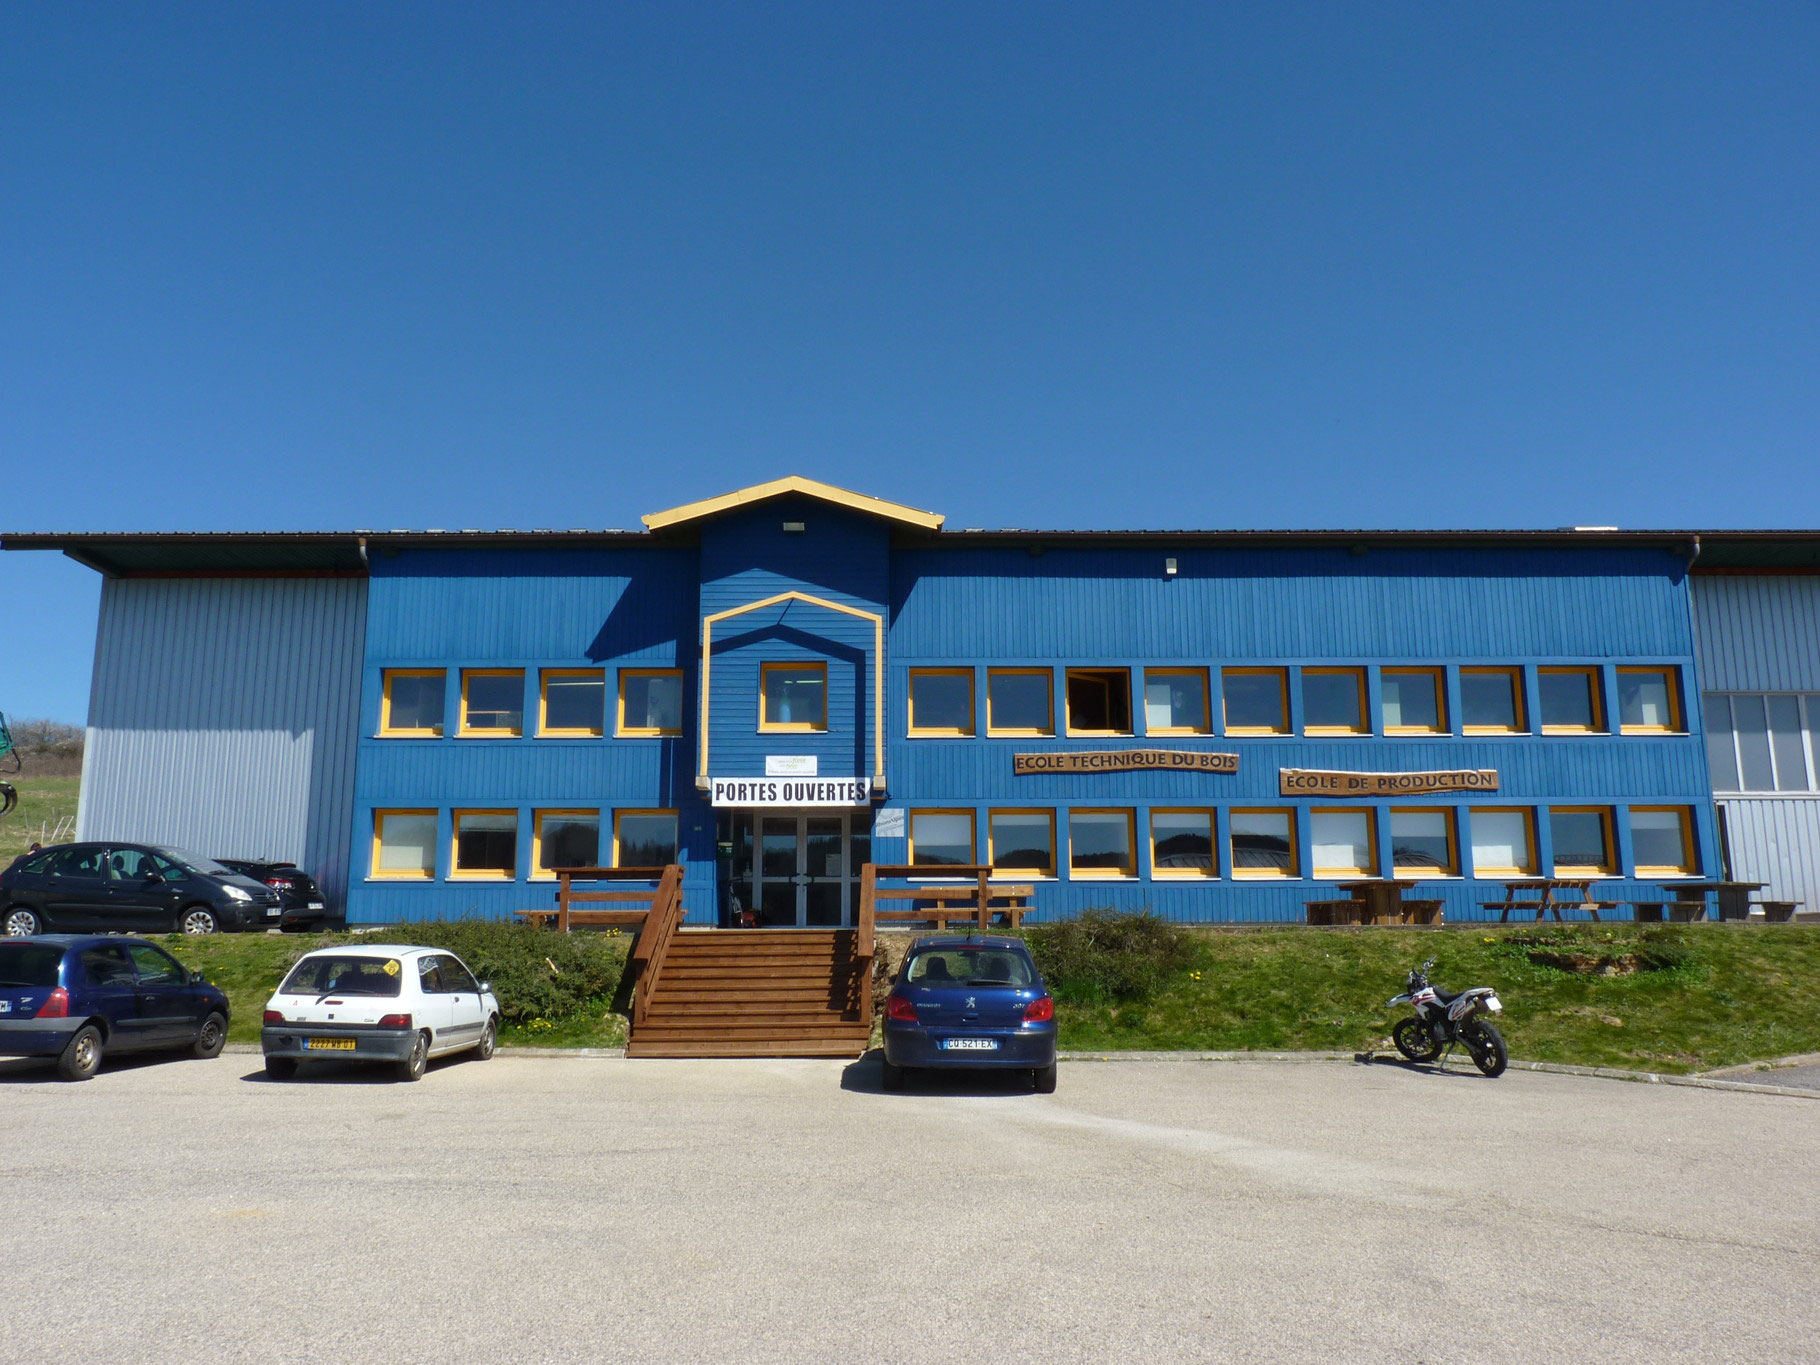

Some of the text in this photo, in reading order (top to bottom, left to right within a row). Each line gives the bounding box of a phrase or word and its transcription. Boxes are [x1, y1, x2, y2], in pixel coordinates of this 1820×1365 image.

[1016, 752, 1235, 769] ECOLE TECHNIQUE DU BOIS
[1286, 773, 1493, 789] ECOLE DE PRODUCTION
[715, 782, 866, 801] PORTES OUVERTES
[962, 1039, 978, 1048] 521
[981, 1039, 993, 1048] EX
